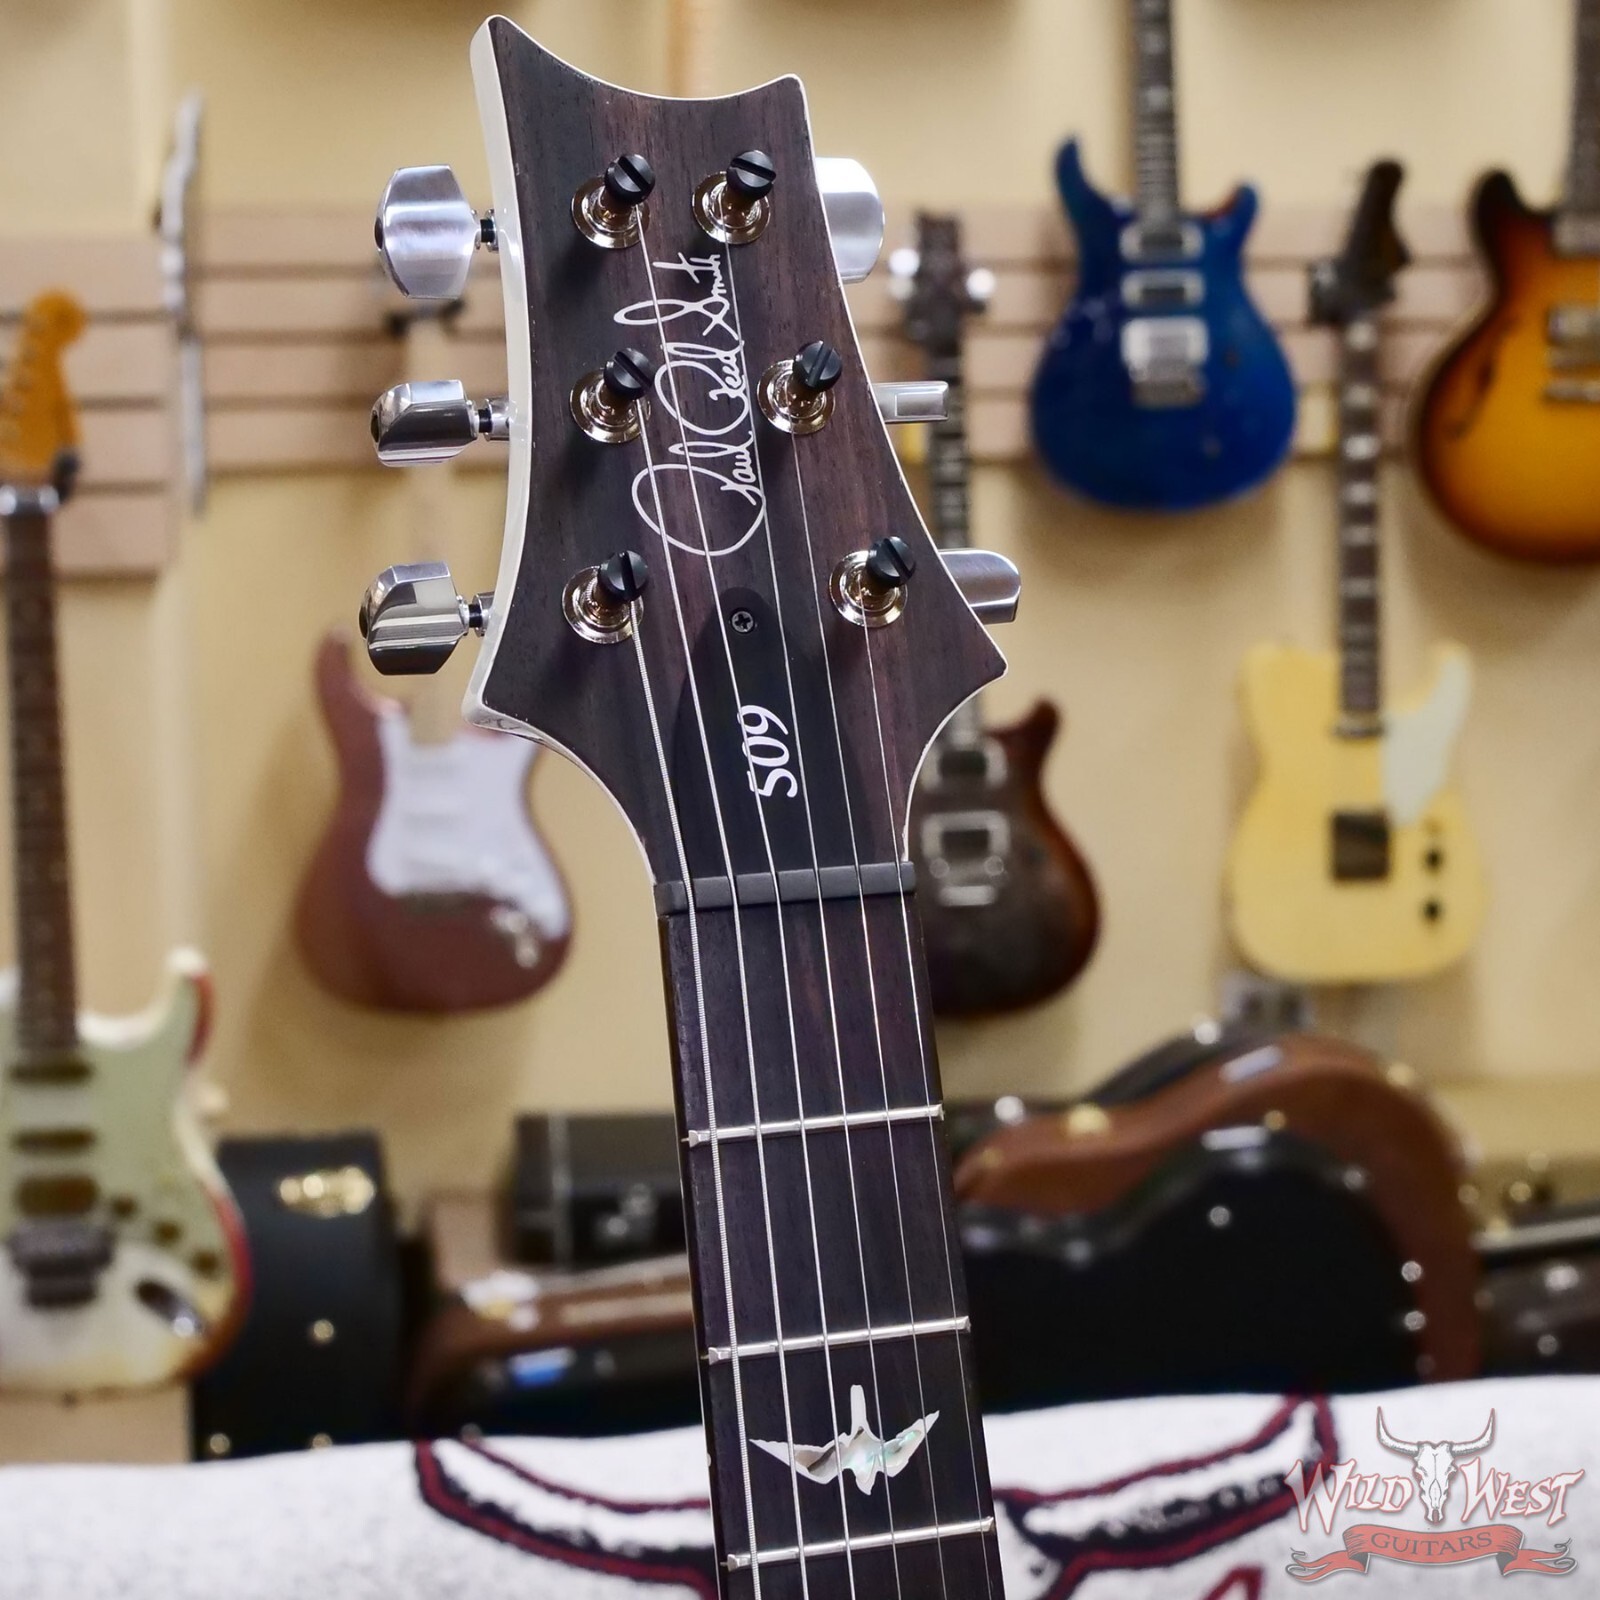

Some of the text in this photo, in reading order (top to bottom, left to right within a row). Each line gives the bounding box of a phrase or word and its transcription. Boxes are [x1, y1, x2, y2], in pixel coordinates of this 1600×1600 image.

[613, 251, 766, 557] Paul Reed Smith
[736, 704, 799, 798] 509
